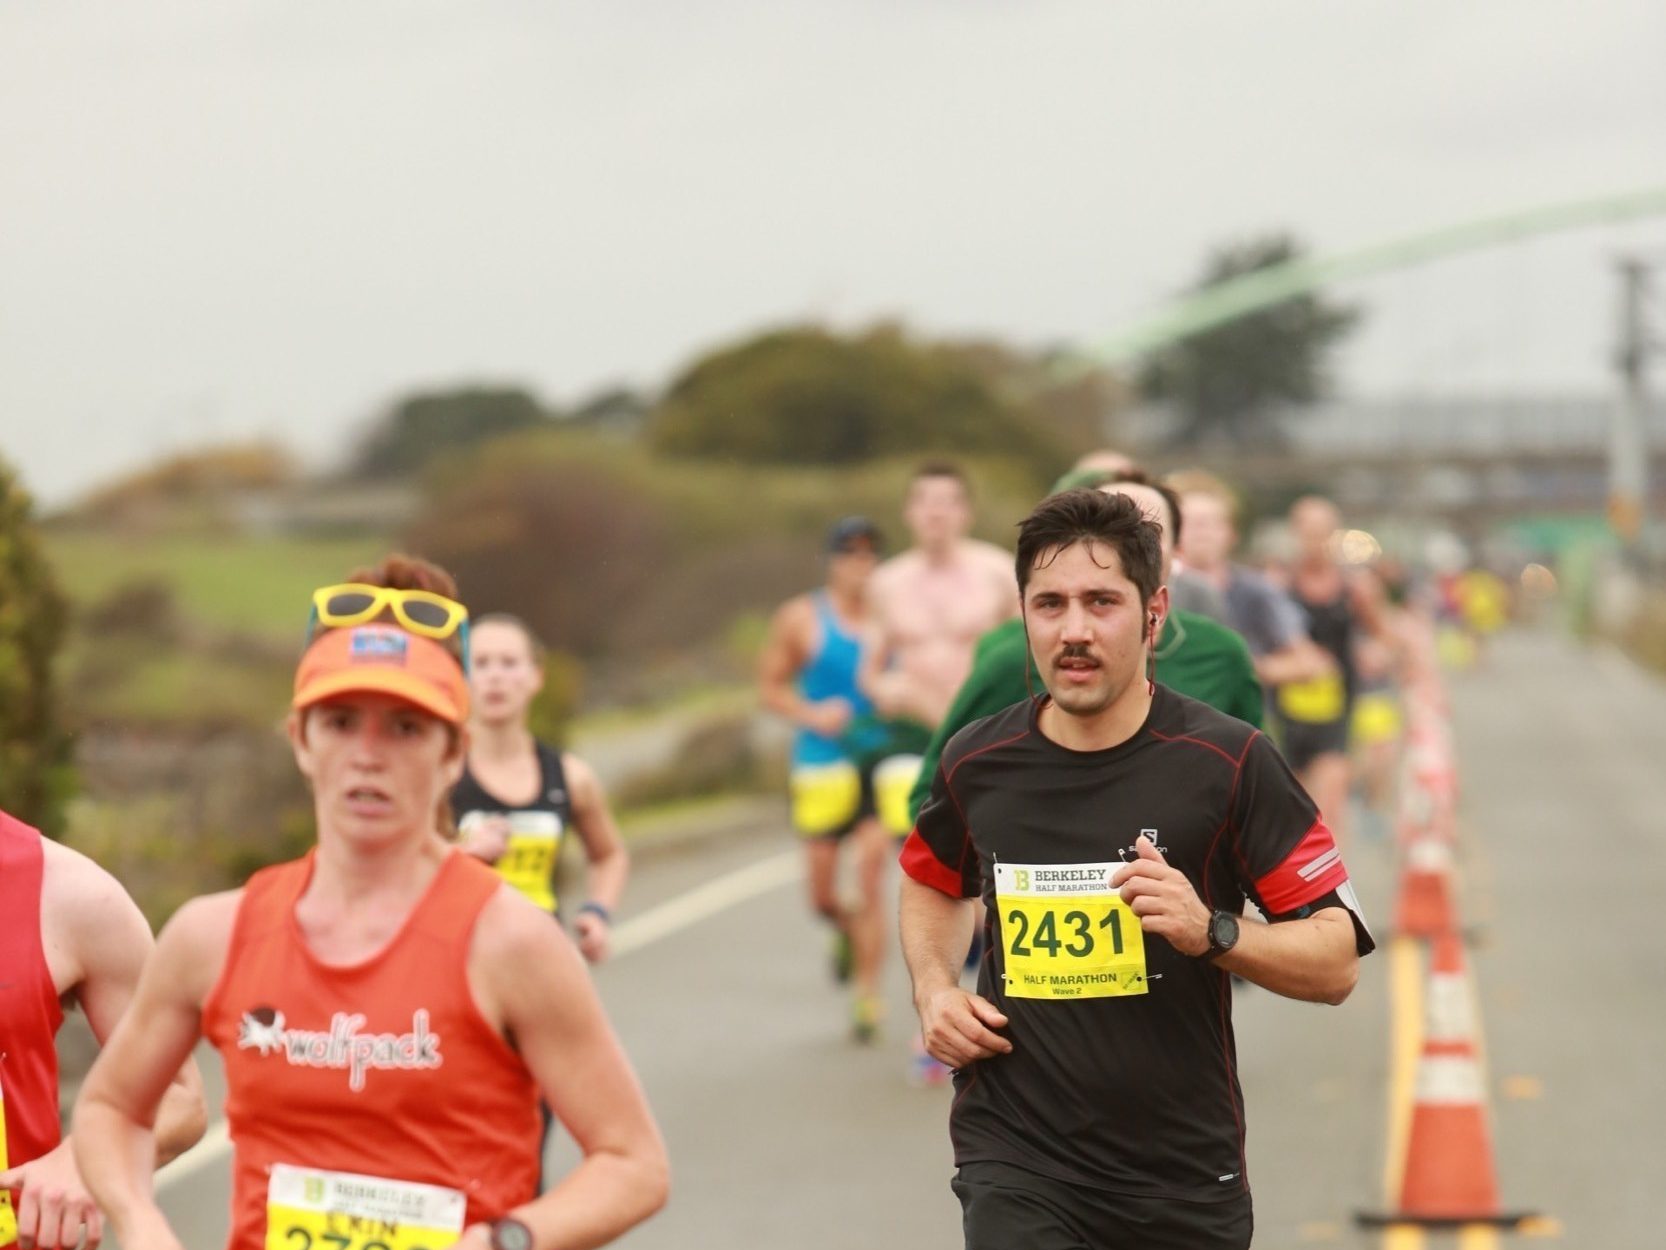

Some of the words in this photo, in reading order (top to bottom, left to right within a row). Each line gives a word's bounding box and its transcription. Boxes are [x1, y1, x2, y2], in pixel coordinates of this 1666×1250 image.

[1034, 869, 1106, 881] BERKELEY
[1035, 884, 1056, 892] HALF
[1058, 883, 1107, 892] MARATHON
[1008, 908, 1124, 957] 2431
[1023, 974, 1047, 985] HALF
[1050, 972, 1117, 985] MARATHON
[1052, 988, 1075, 996] Wave
[1076, 987, 1083, 995] 2
[284, 1008, 443, 1092] wolfpack
